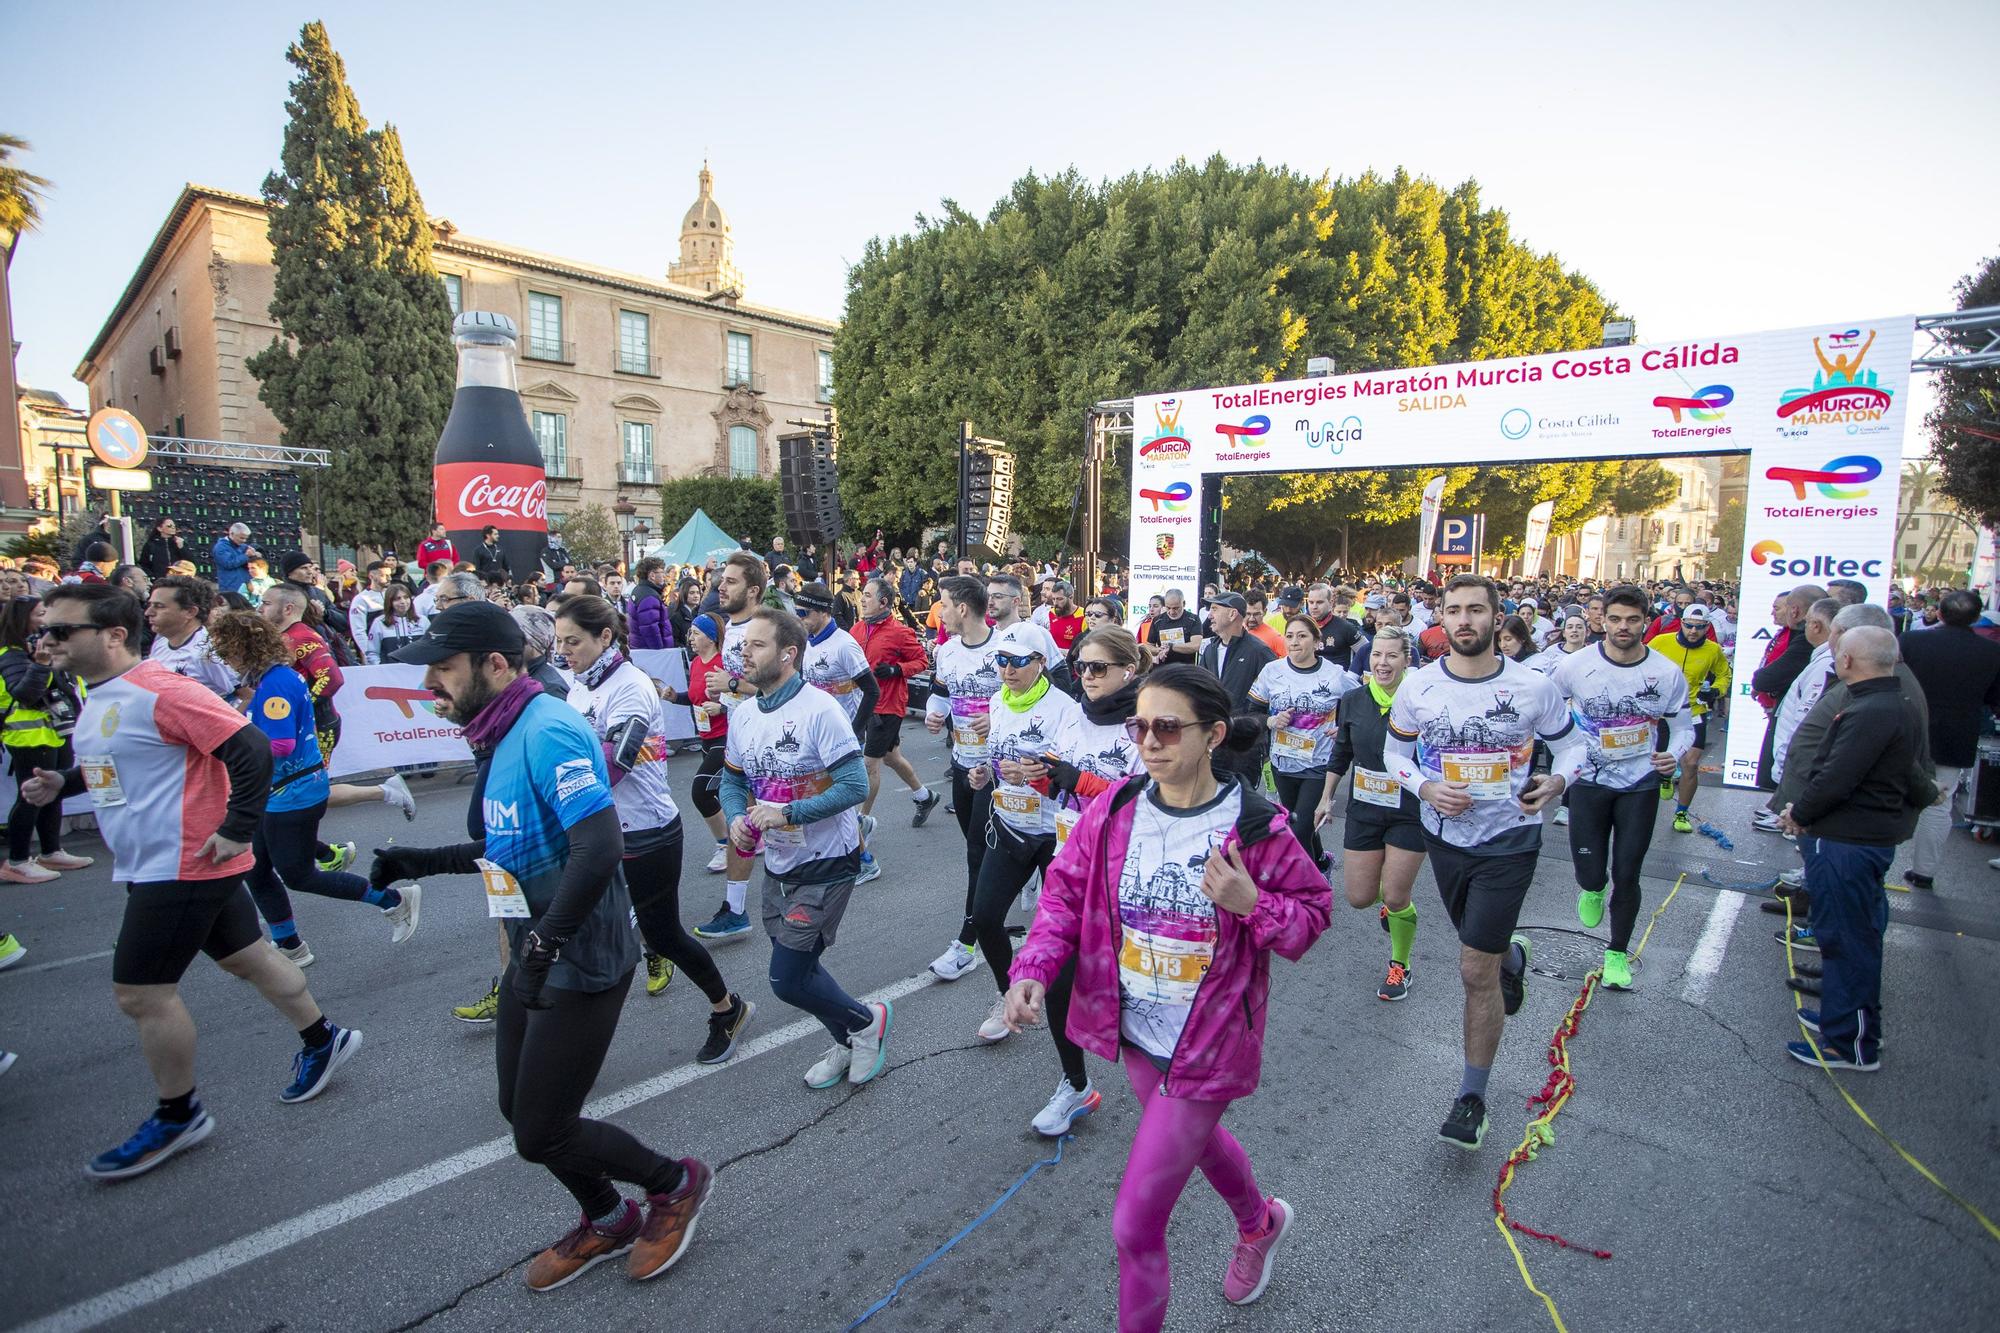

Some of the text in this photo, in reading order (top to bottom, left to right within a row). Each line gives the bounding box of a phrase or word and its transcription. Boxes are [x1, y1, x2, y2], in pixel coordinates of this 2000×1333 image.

[1212, 342, 1739, 409] TotalEnergies Maratón Murcia Costa Cálida
[1398, 393, 1467, 412] SALIDA
[1808, 396, 1885, 413] MURCIA
[1538, 413, 1620, 429] Costa Cálida
[1652, 425, 1732, 438] TotalEnergies
[1153, 443, 1189, 453] MURCIA
[1215, 451, 1271, 462] TotalEnergies
[1139, 514, 1192, 525] TotalEnergies
[1763, 505, 1878, 520] TotalEnergies
[1442, 519, 1467, 551] P
[1133, 564, 1196, 572] PORSCHE
[1769, 555, 1882, 578] soltec
[373, 727, 464, 744] TotalEnerg
[1459, 766, 1493, 780] 5937
[1731, 771, 1756, 781] CENT
[1002, 796, 1028, 810] 6535
[1140, 950, 1182, 977] 5713
